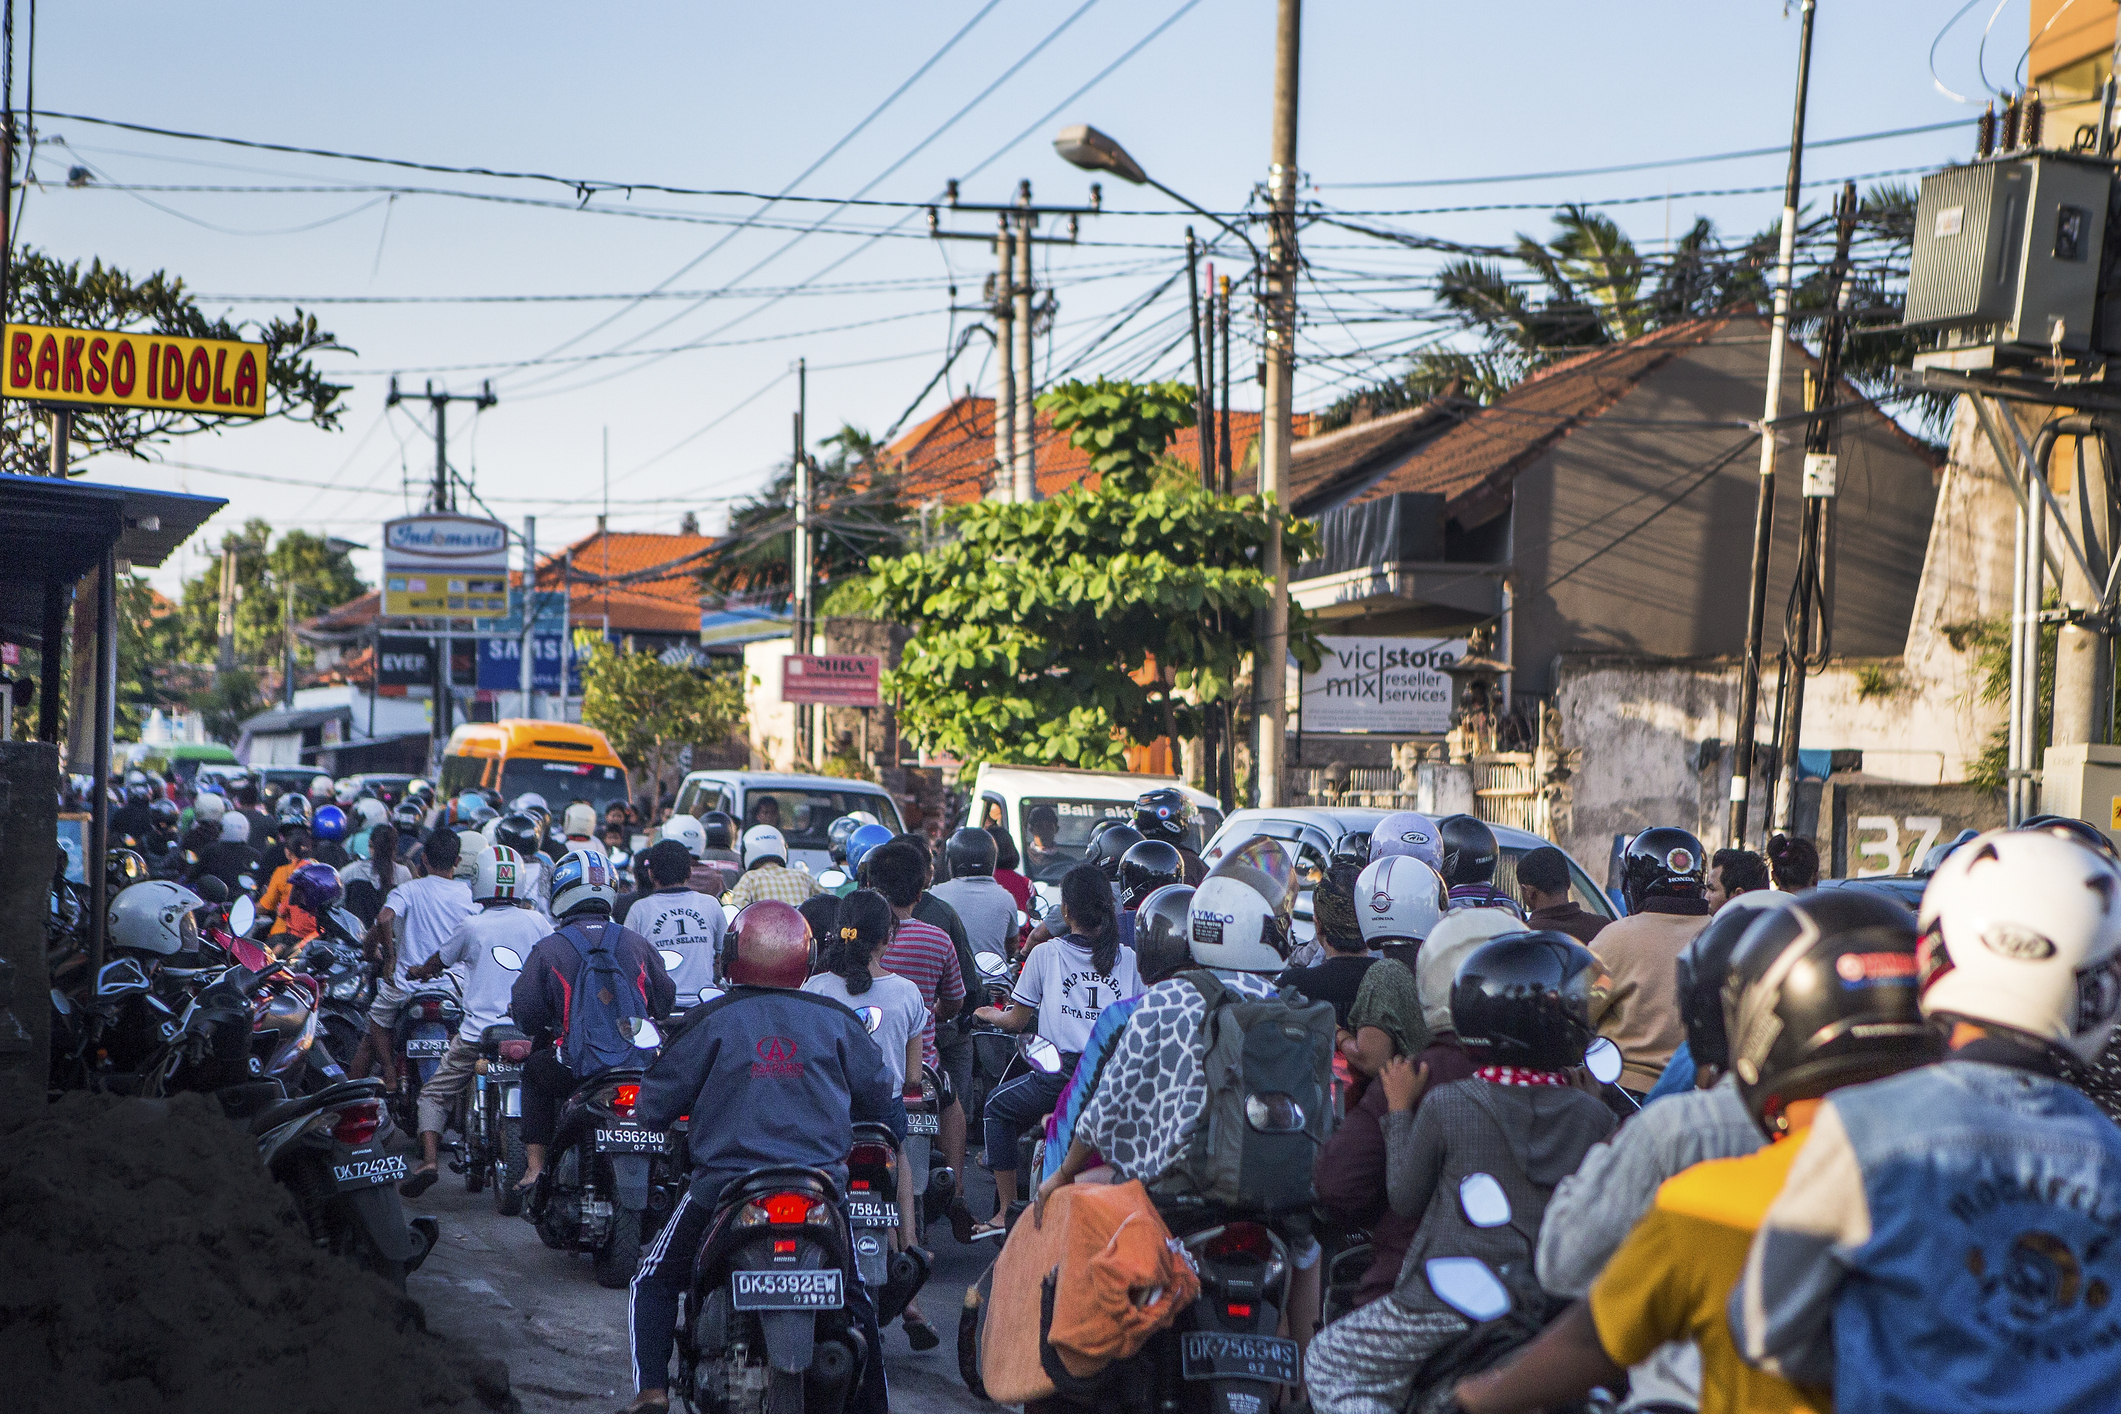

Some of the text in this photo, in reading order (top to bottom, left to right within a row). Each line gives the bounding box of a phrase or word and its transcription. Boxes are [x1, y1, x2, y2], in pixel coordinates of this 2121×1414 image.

[10, 332, 257, 407] BAKSO IDOLA
[1326, 671, 1442, 698] mix reseller
[1385, 687, 1447, 702] services
[1057, 803, 1095, 817] Bali
[1857, 816, 1942, 879] 37
[669, 908, 707, 930] NEGERI
[674, 918, 688, 936] 1
[676, 936, 708, 945] SELATAN
[1062, 971, 1122, 1001] SMP NEGER
[1084, 986, 1102, 1010] 1
